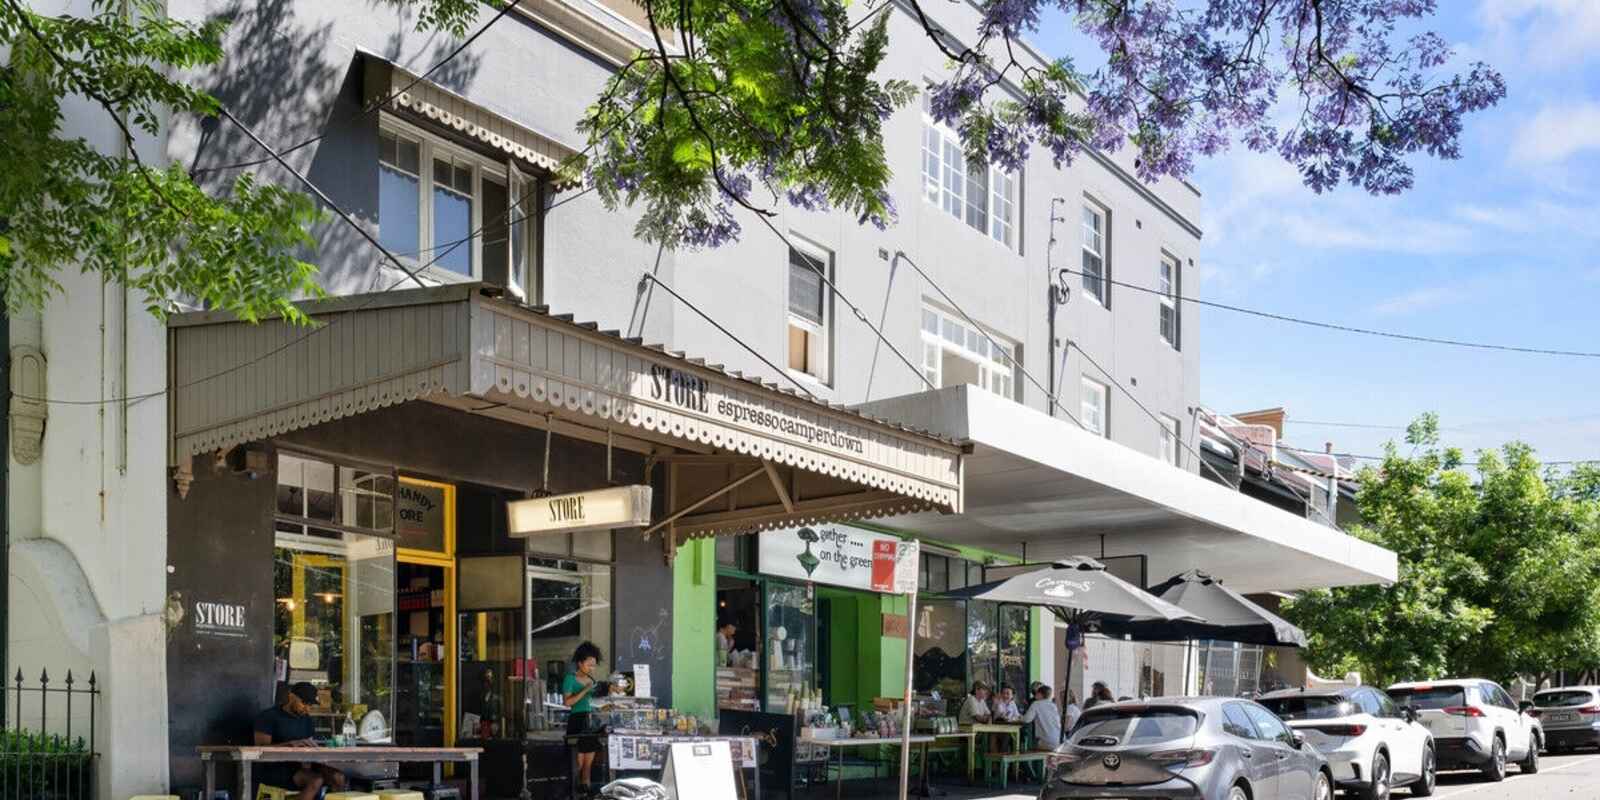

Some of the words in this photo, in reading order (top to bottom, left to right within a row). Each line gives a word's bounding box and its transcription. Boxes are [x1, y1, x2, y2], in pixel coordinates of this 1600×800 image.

[650, 363, 709, 414] STORE
[717, 399, 863, 453] espressocamperdown
[548, 495, 585, 522] STORE
[820, 528, 847, 548] gather
[820, 550, 831, 561] on
[834, 549, 848, 571] the
[849, 555, 873, 569] green
[196, 601, 245, 627] STORE
